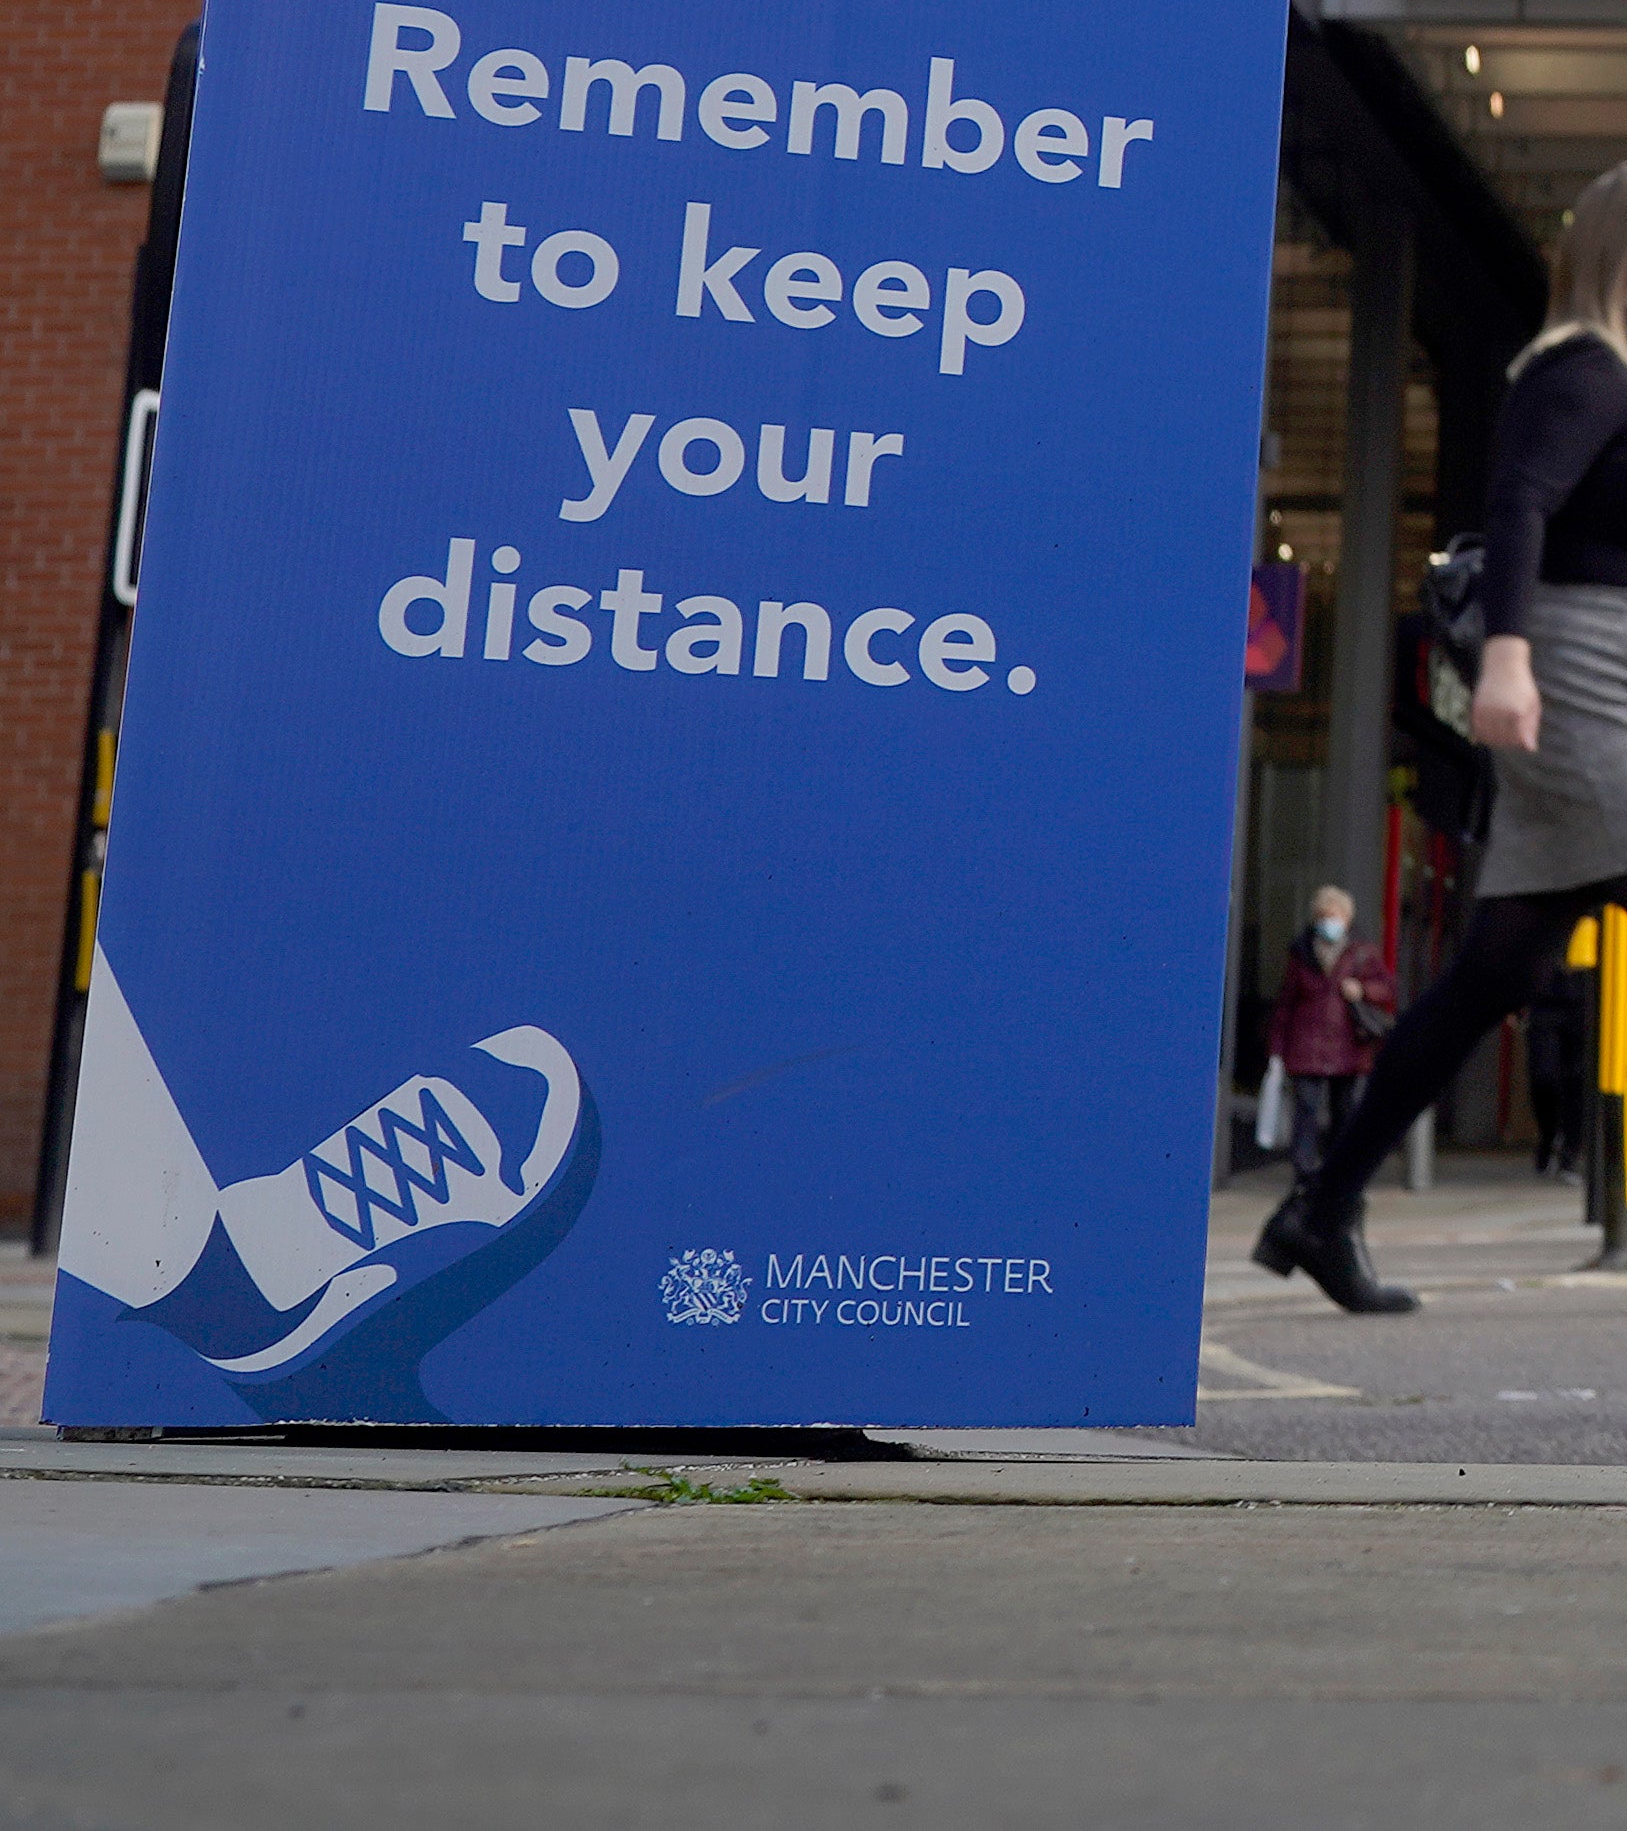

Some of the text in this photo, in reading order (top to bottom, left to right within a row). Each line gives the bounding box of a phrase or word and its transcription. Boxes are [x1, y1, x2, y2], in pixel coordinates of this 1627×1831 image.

[363, 2, 1154, 189] Remember
[462, 201, 1027, 376] to keep
[558, 408, 904, 522] your
[378, 537, 1037, 695] distance.
[761, 1298, 971, 1327] CITY COUNCIL
[765, 1253, 1054, 1295] MANCHESTER
